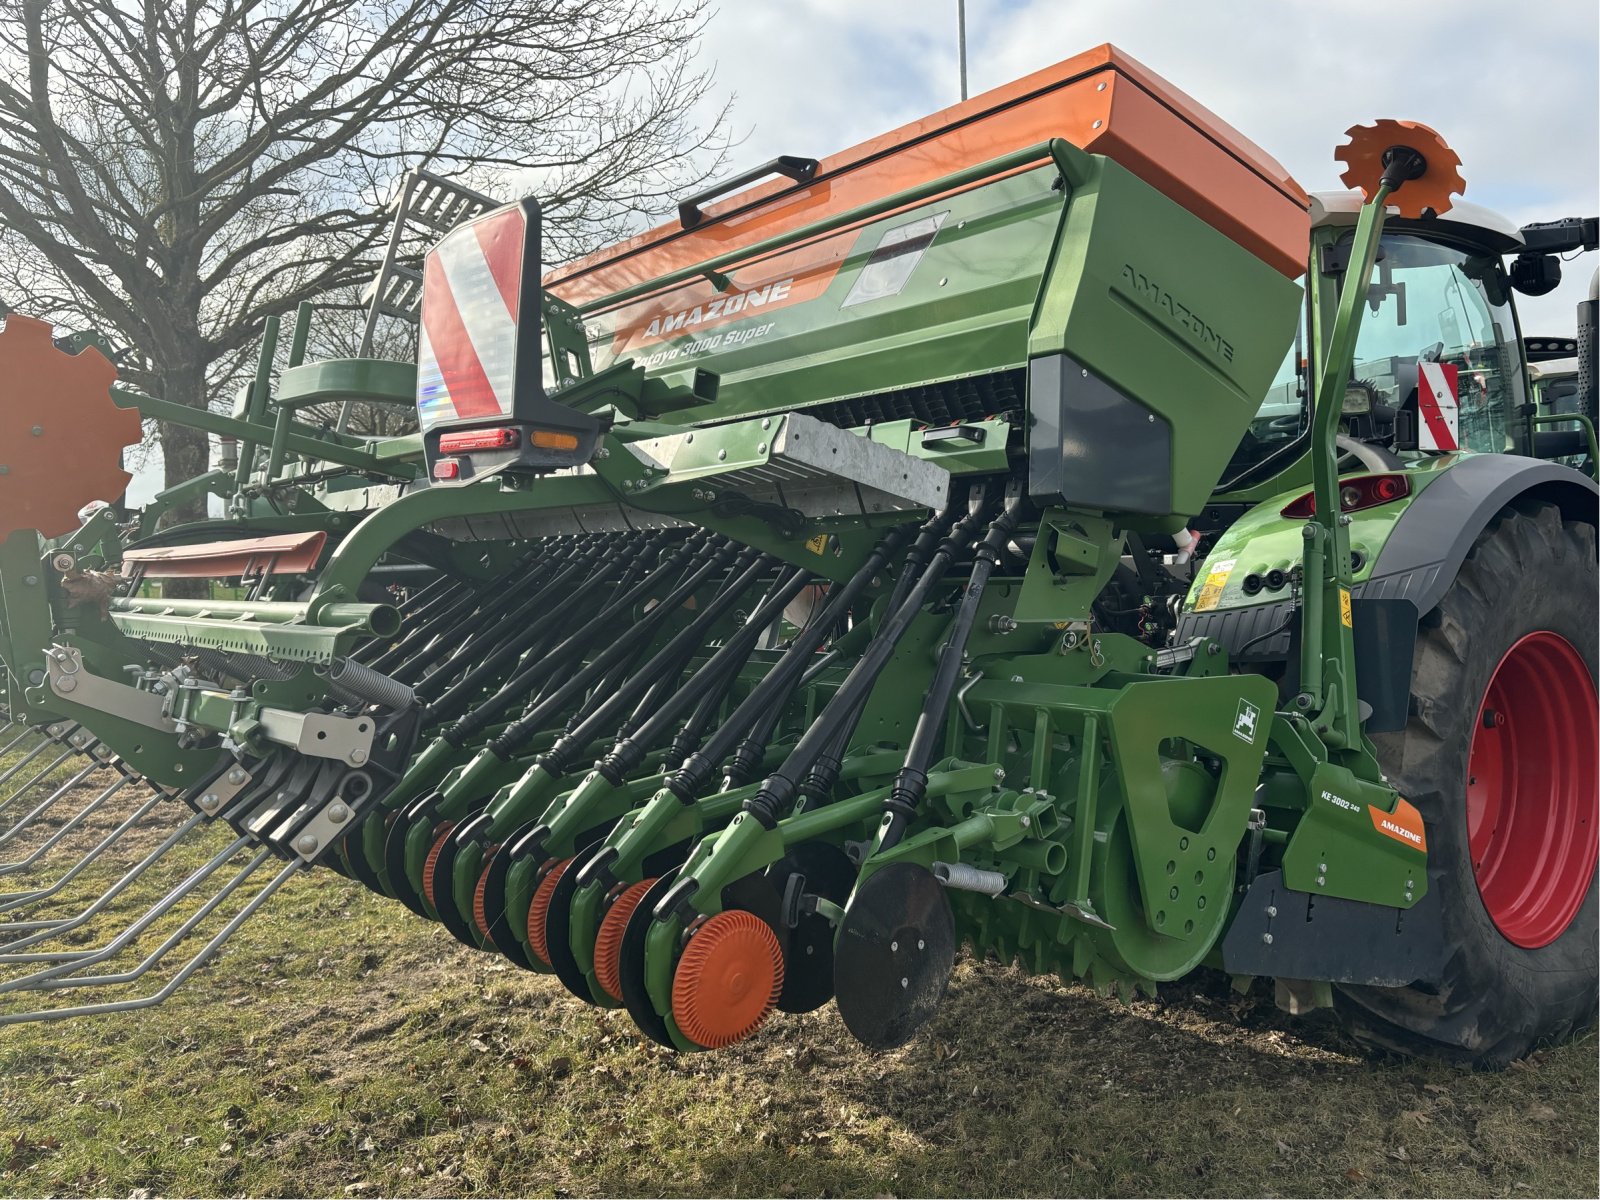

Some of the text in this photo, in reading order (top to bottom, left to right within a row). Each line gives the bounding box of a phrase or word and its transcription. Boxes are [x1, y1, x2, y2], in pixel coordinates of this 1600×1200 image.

[642, 278, 794, 340] AMAZONE
[1121, 263, 1235, 363] AMAZONE
[681, 334, 722, 357] 3000
[723, 322, 775, 346] Super
[1321, 790, 1332, 801] KE
[1331, 795, 1350, 810] 3002
[1381, 819, 1422, 844] AMAZONE
